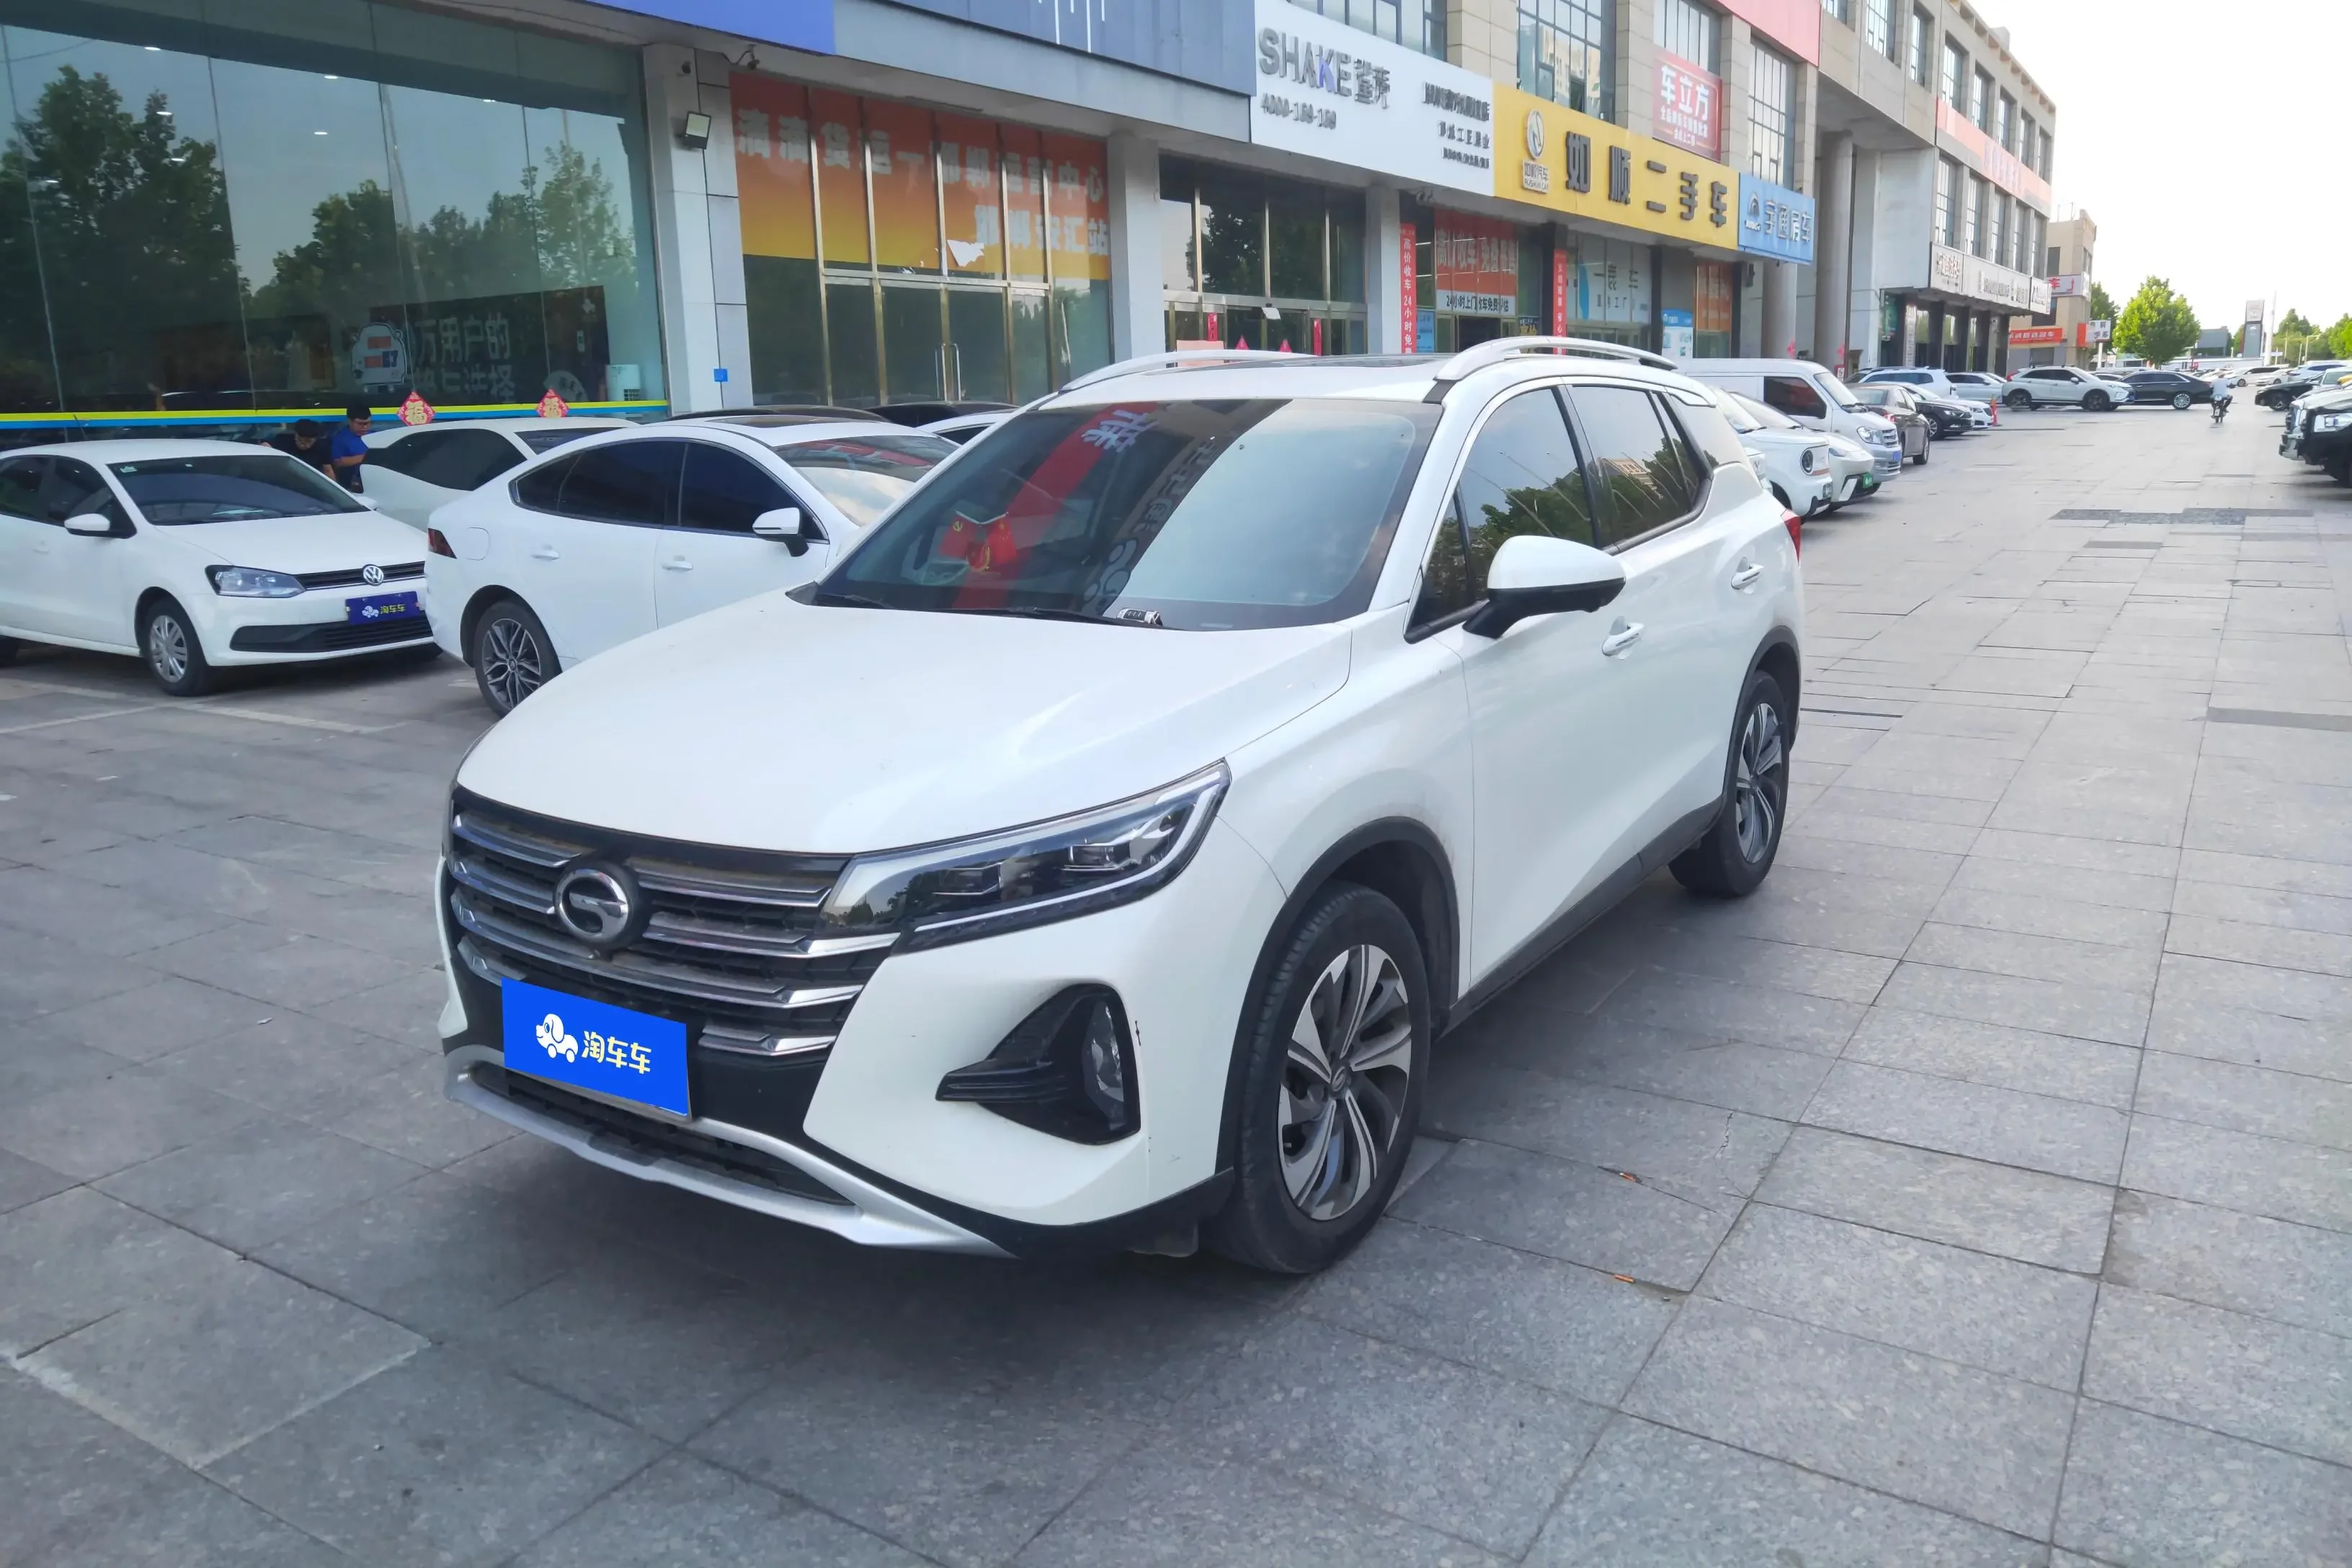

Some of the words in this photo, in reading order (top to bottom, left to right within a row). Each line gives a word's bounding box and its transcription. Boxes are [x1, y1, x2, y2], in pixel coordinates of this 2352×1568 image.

[1260, 27, 1352, 97] SHAKE
[1660, 64, 1710, 121] 车立方
[1565, 130, 1728, 228] 如顺二手车
[1403, 238, 1412, 291] 高价收车
[404, 400, 427, 424] 福
[543, 395, 563, 418] 福
